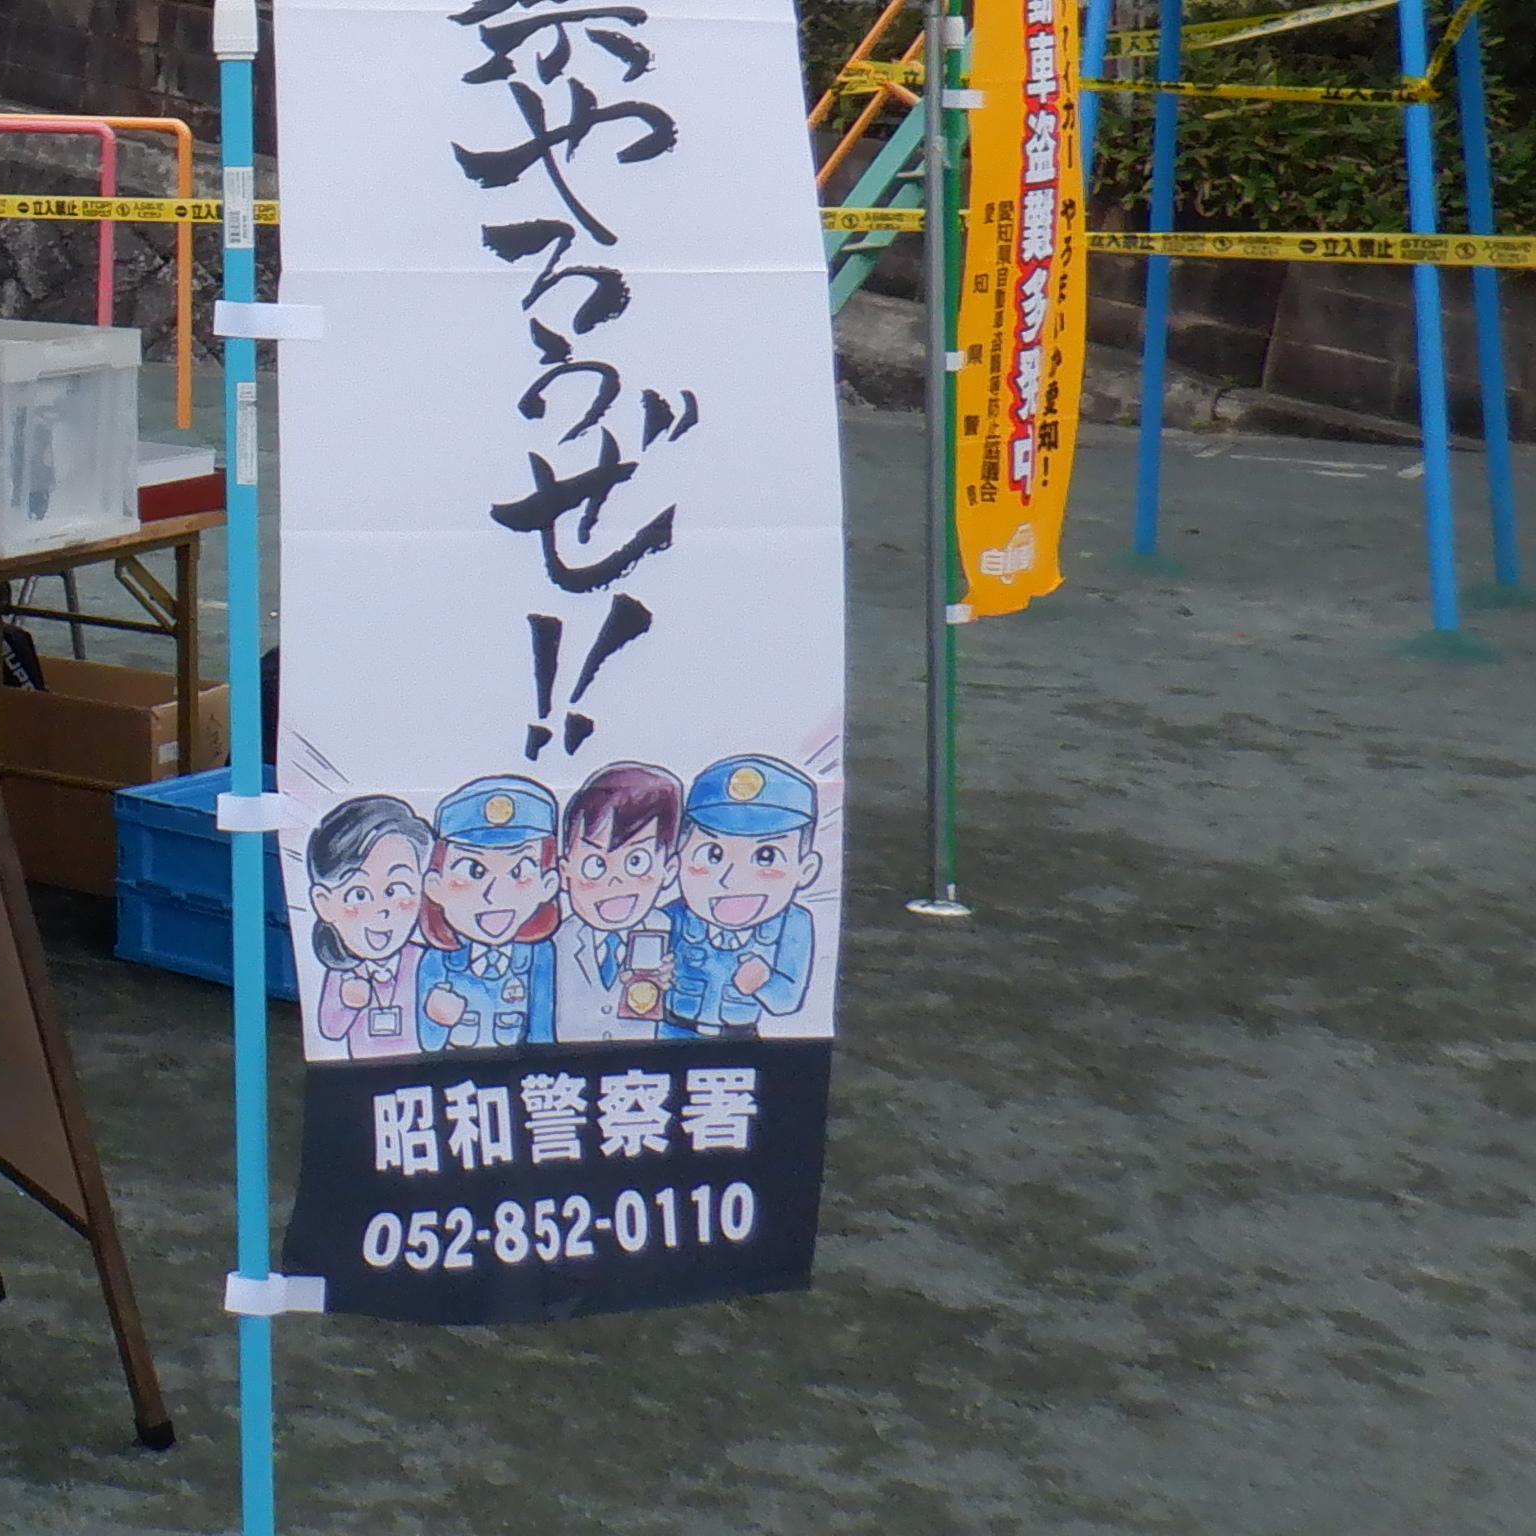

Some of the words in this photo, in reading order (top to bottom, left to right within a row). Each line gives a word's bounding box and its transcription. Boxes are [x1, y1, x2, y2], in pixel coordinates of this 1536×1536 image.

[374, 1067, 758, 1176] 昭和警察署
[362, 1182, 756, 1270] 052-852-0110
